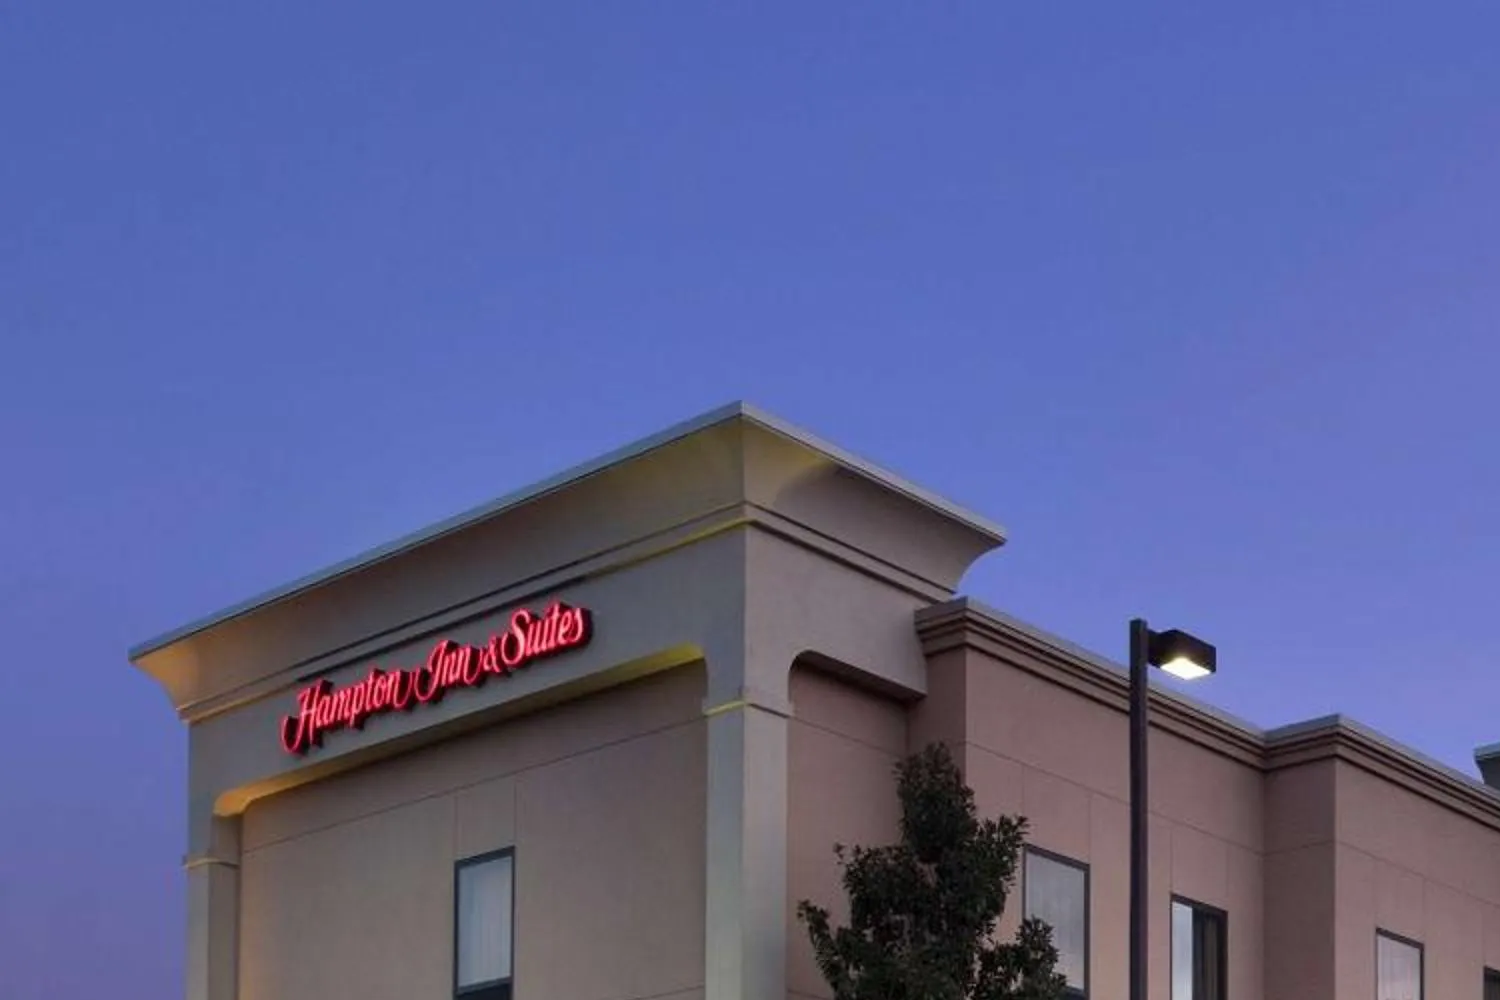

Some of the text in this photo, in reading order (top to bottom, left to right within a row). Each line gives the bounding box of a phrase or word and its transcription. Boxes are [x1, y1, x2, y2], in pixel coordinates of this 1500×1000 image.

[280, 668, 413, 754] Hampton
[414, 640, 483, 702] Inn
[501, 602, 586, 667] Suites
